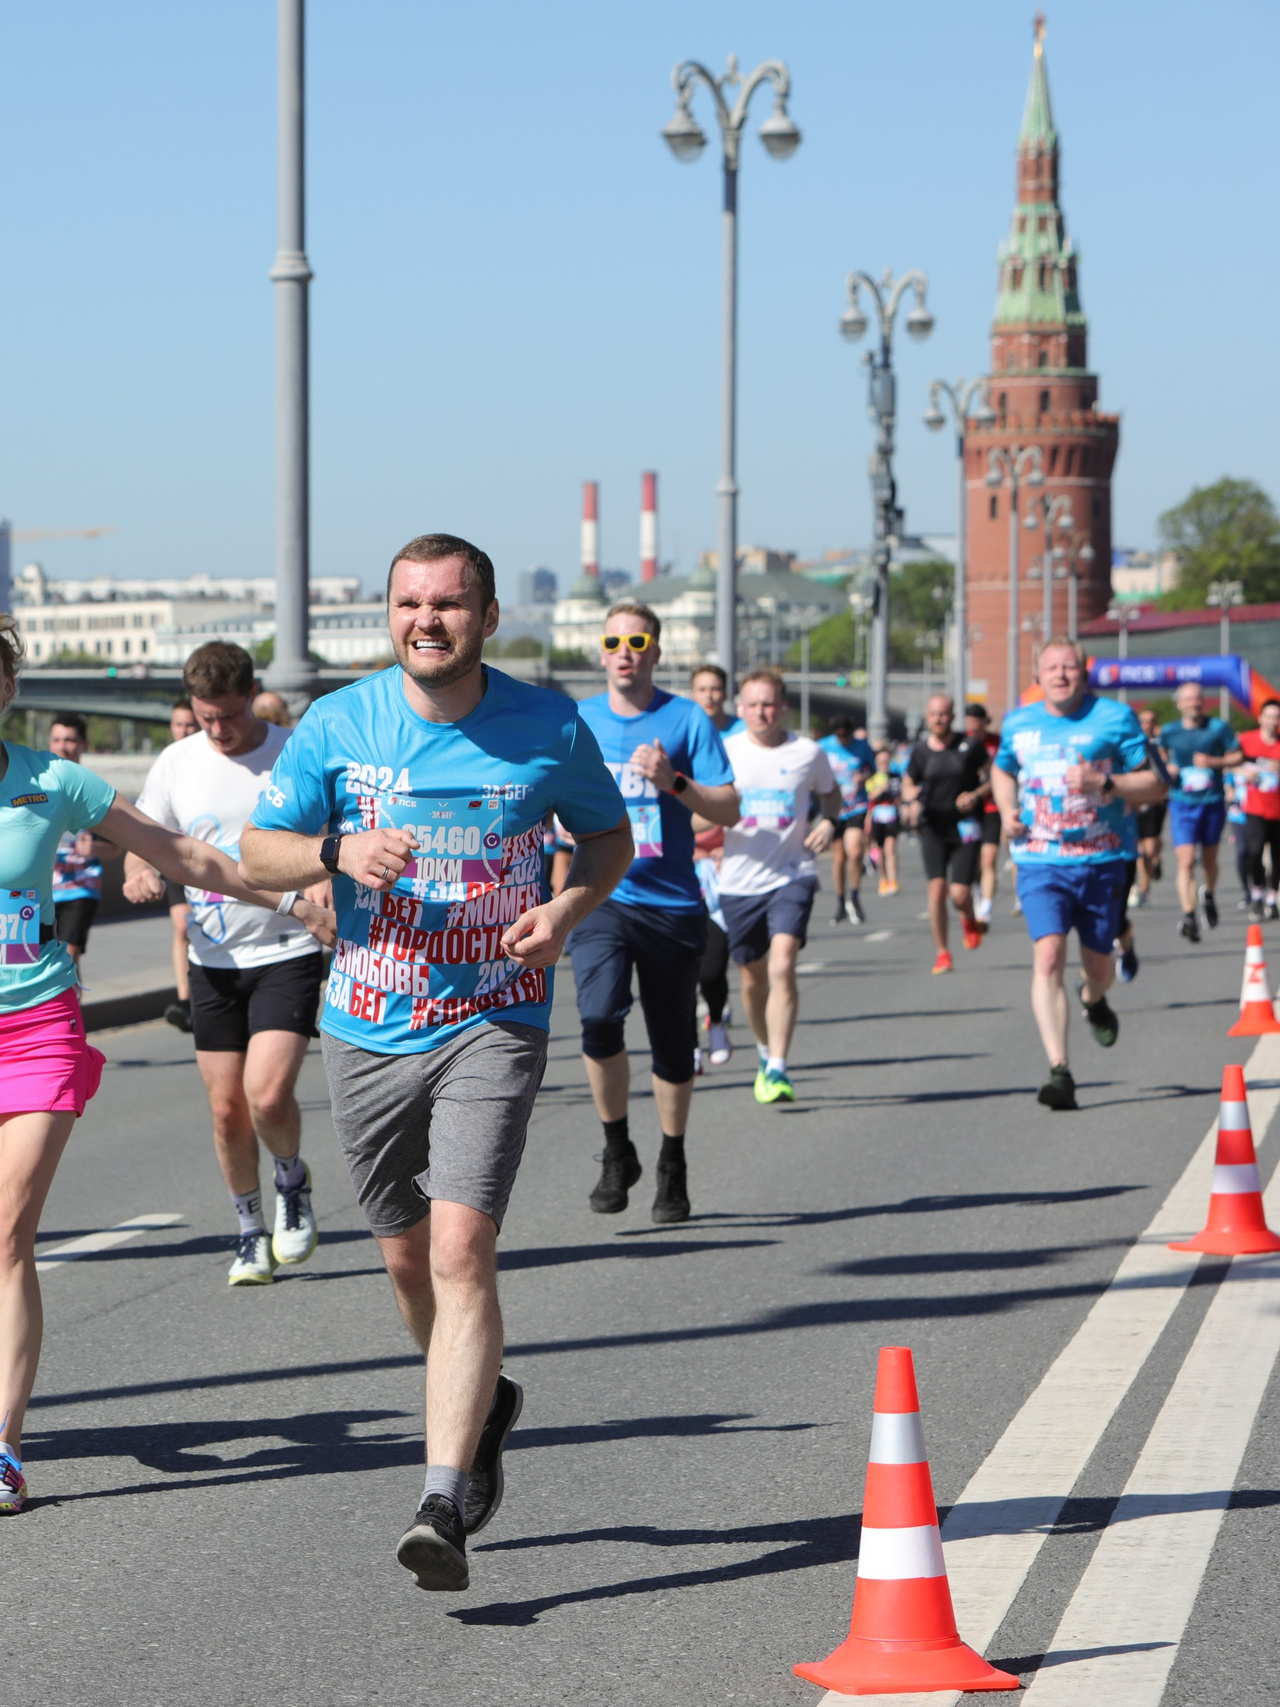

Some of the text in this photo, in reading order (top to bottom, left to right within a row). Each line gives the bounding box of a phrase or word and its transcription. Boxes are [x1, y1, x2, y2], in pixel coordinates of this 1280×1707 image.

[345, 761, 413, 796] 2024
[13, 794, 47, 807] METRO
[399, 798, 417, 808] ПСБ
[415, 857, 463, 883] 10KM
[325, 968, 387, 1026] #ЗАБЕГ
